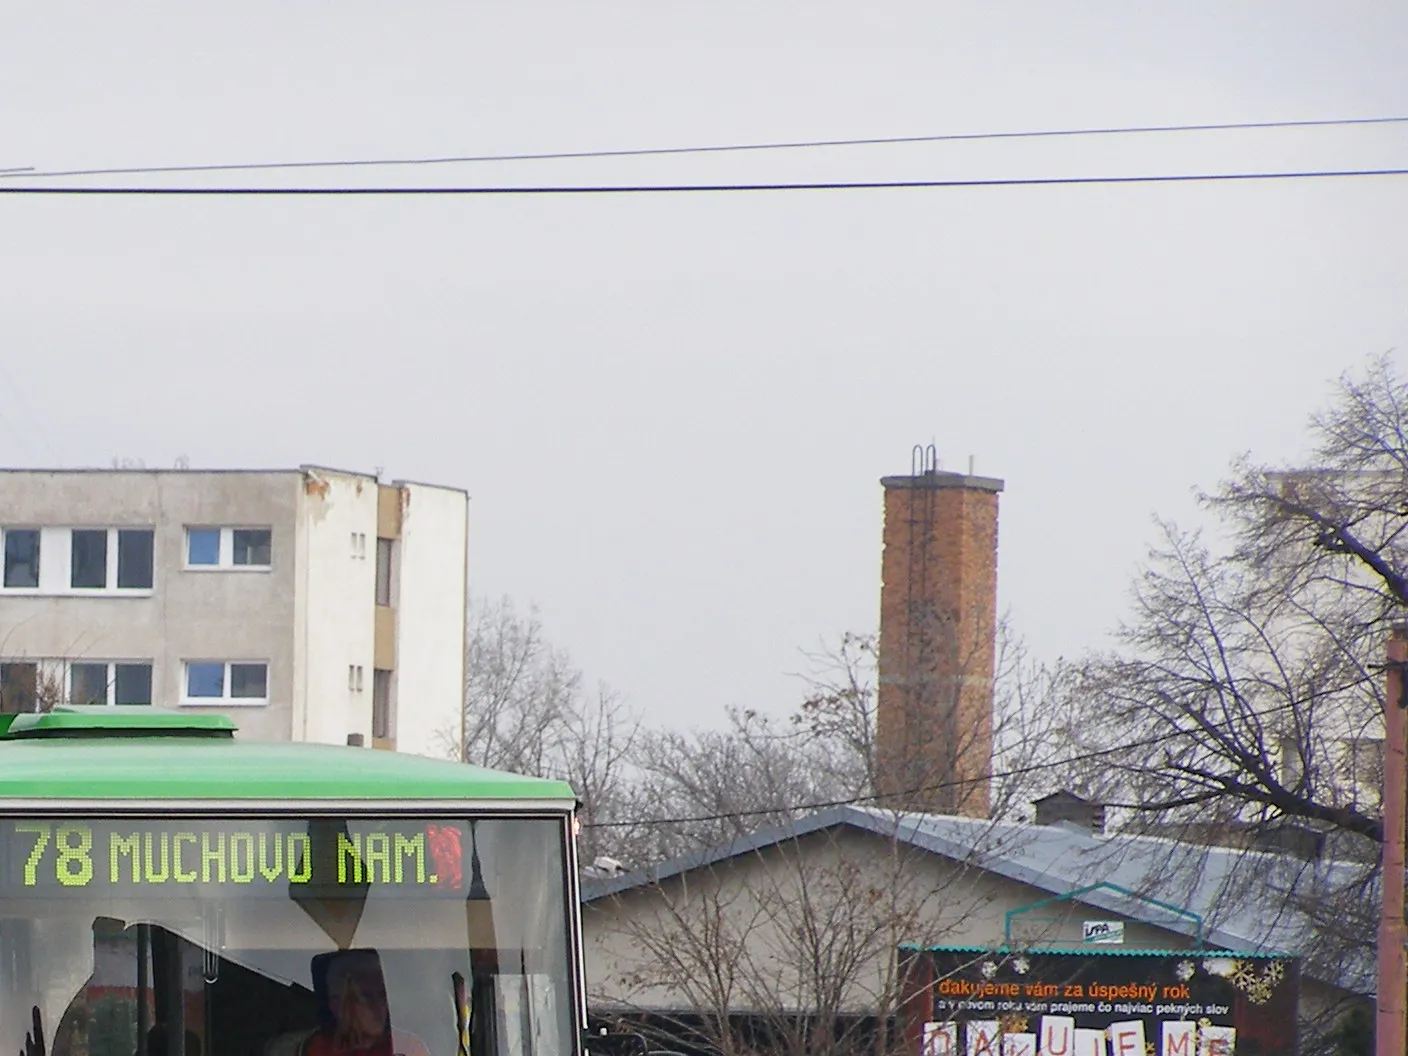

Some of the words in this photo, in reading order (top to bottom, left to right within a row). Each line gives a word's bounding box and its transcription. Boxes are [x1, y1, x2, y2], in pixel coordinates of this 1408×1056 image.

[14, 823, 93, 887] 78
[109, 831, 313, 884] MUCHOVO
[1025, 981, 1058, 998] vám
[1063, 983, 1083, 998] za
[1088, 981, 1157, 1001] úspešný
[1163, 983, 1191, 999] rok
[1050, 1002, 1094, 1015] prajeme
[1098, 1001, 1112, 1013] čo
[1115, 1002, 1153, 1015] najviac
[1156, 1002, 1203, 1016] pekných
[1206, 1004, 1229, 1015] slov
